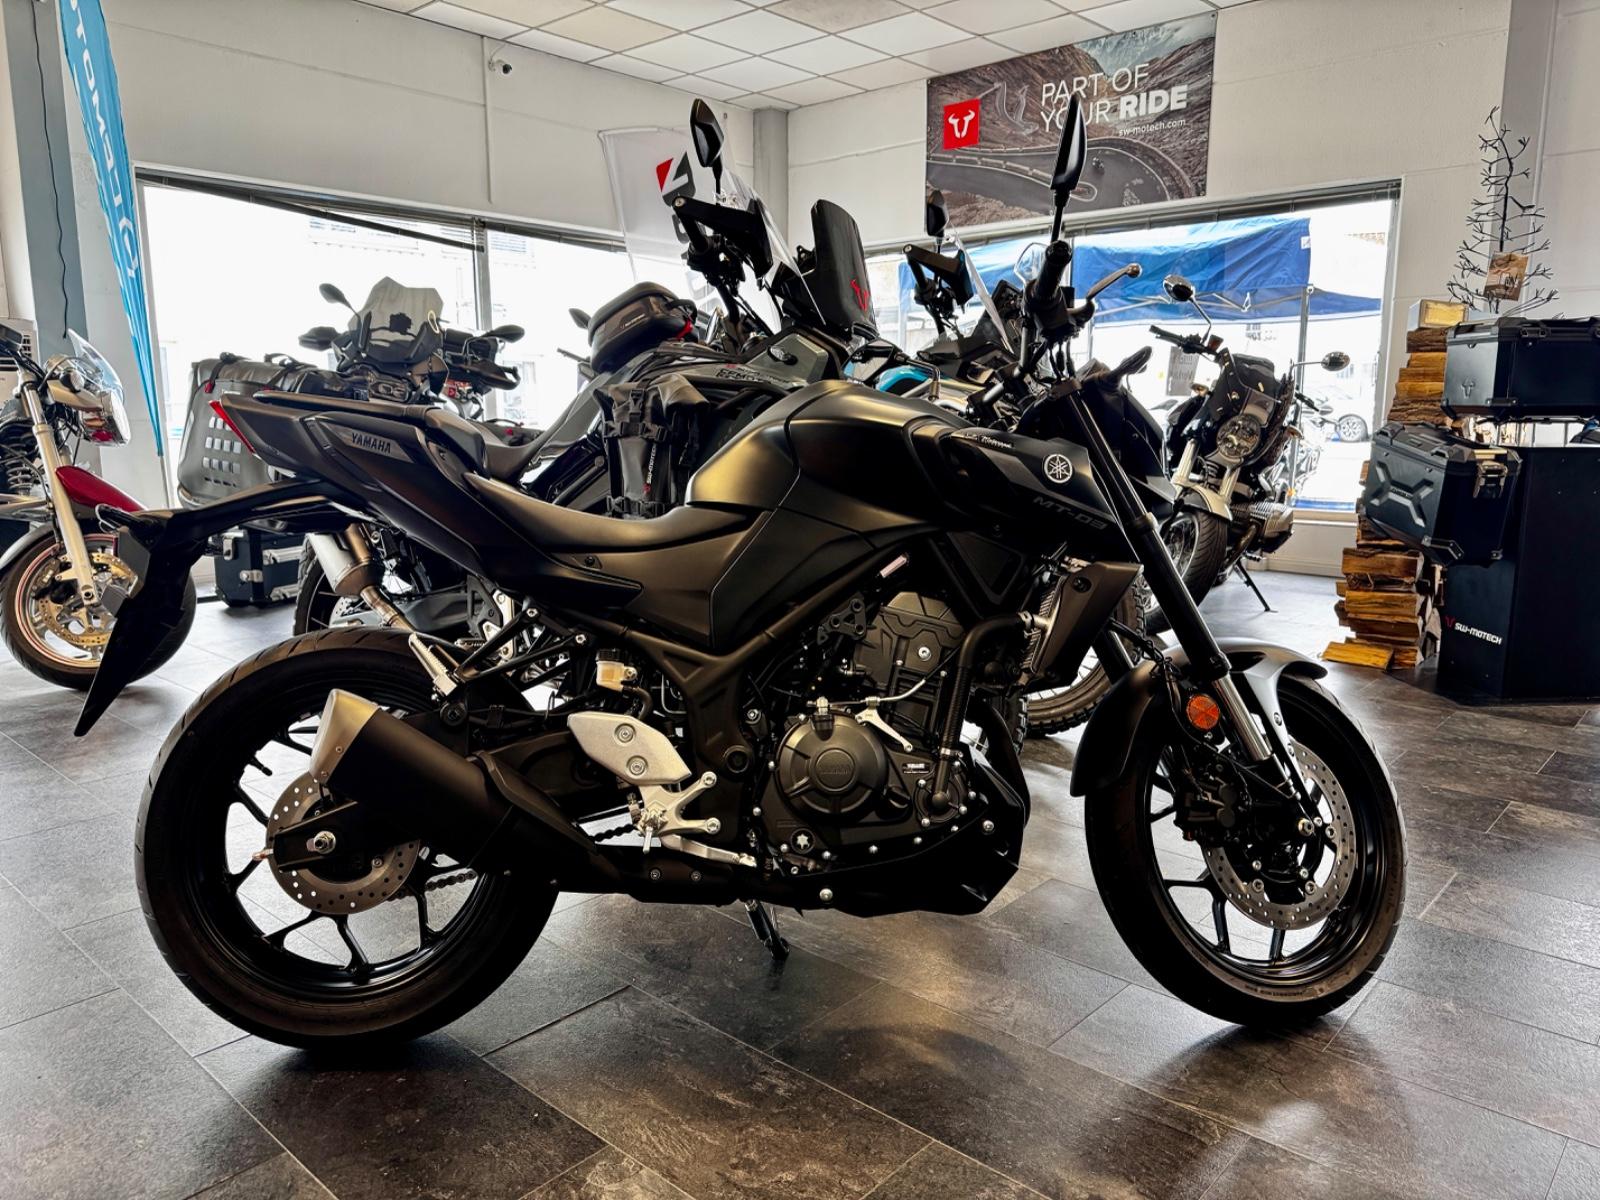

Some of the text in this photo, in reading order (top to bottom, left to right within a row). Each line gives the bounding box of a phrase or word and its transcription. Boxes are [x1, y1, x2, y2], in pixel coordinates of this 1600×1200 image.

[1041, 63, 1149, 106] PART OF
[1119, 84, 1188, 119] RIDE
[1119, 119, 1186, 137] sw-motech.com
[352, 432, 391, 454] YAMAHA
[1032, 496, 1108, 530] MT-03
[1455, 622, 1503, 645] SW-MOTECH
